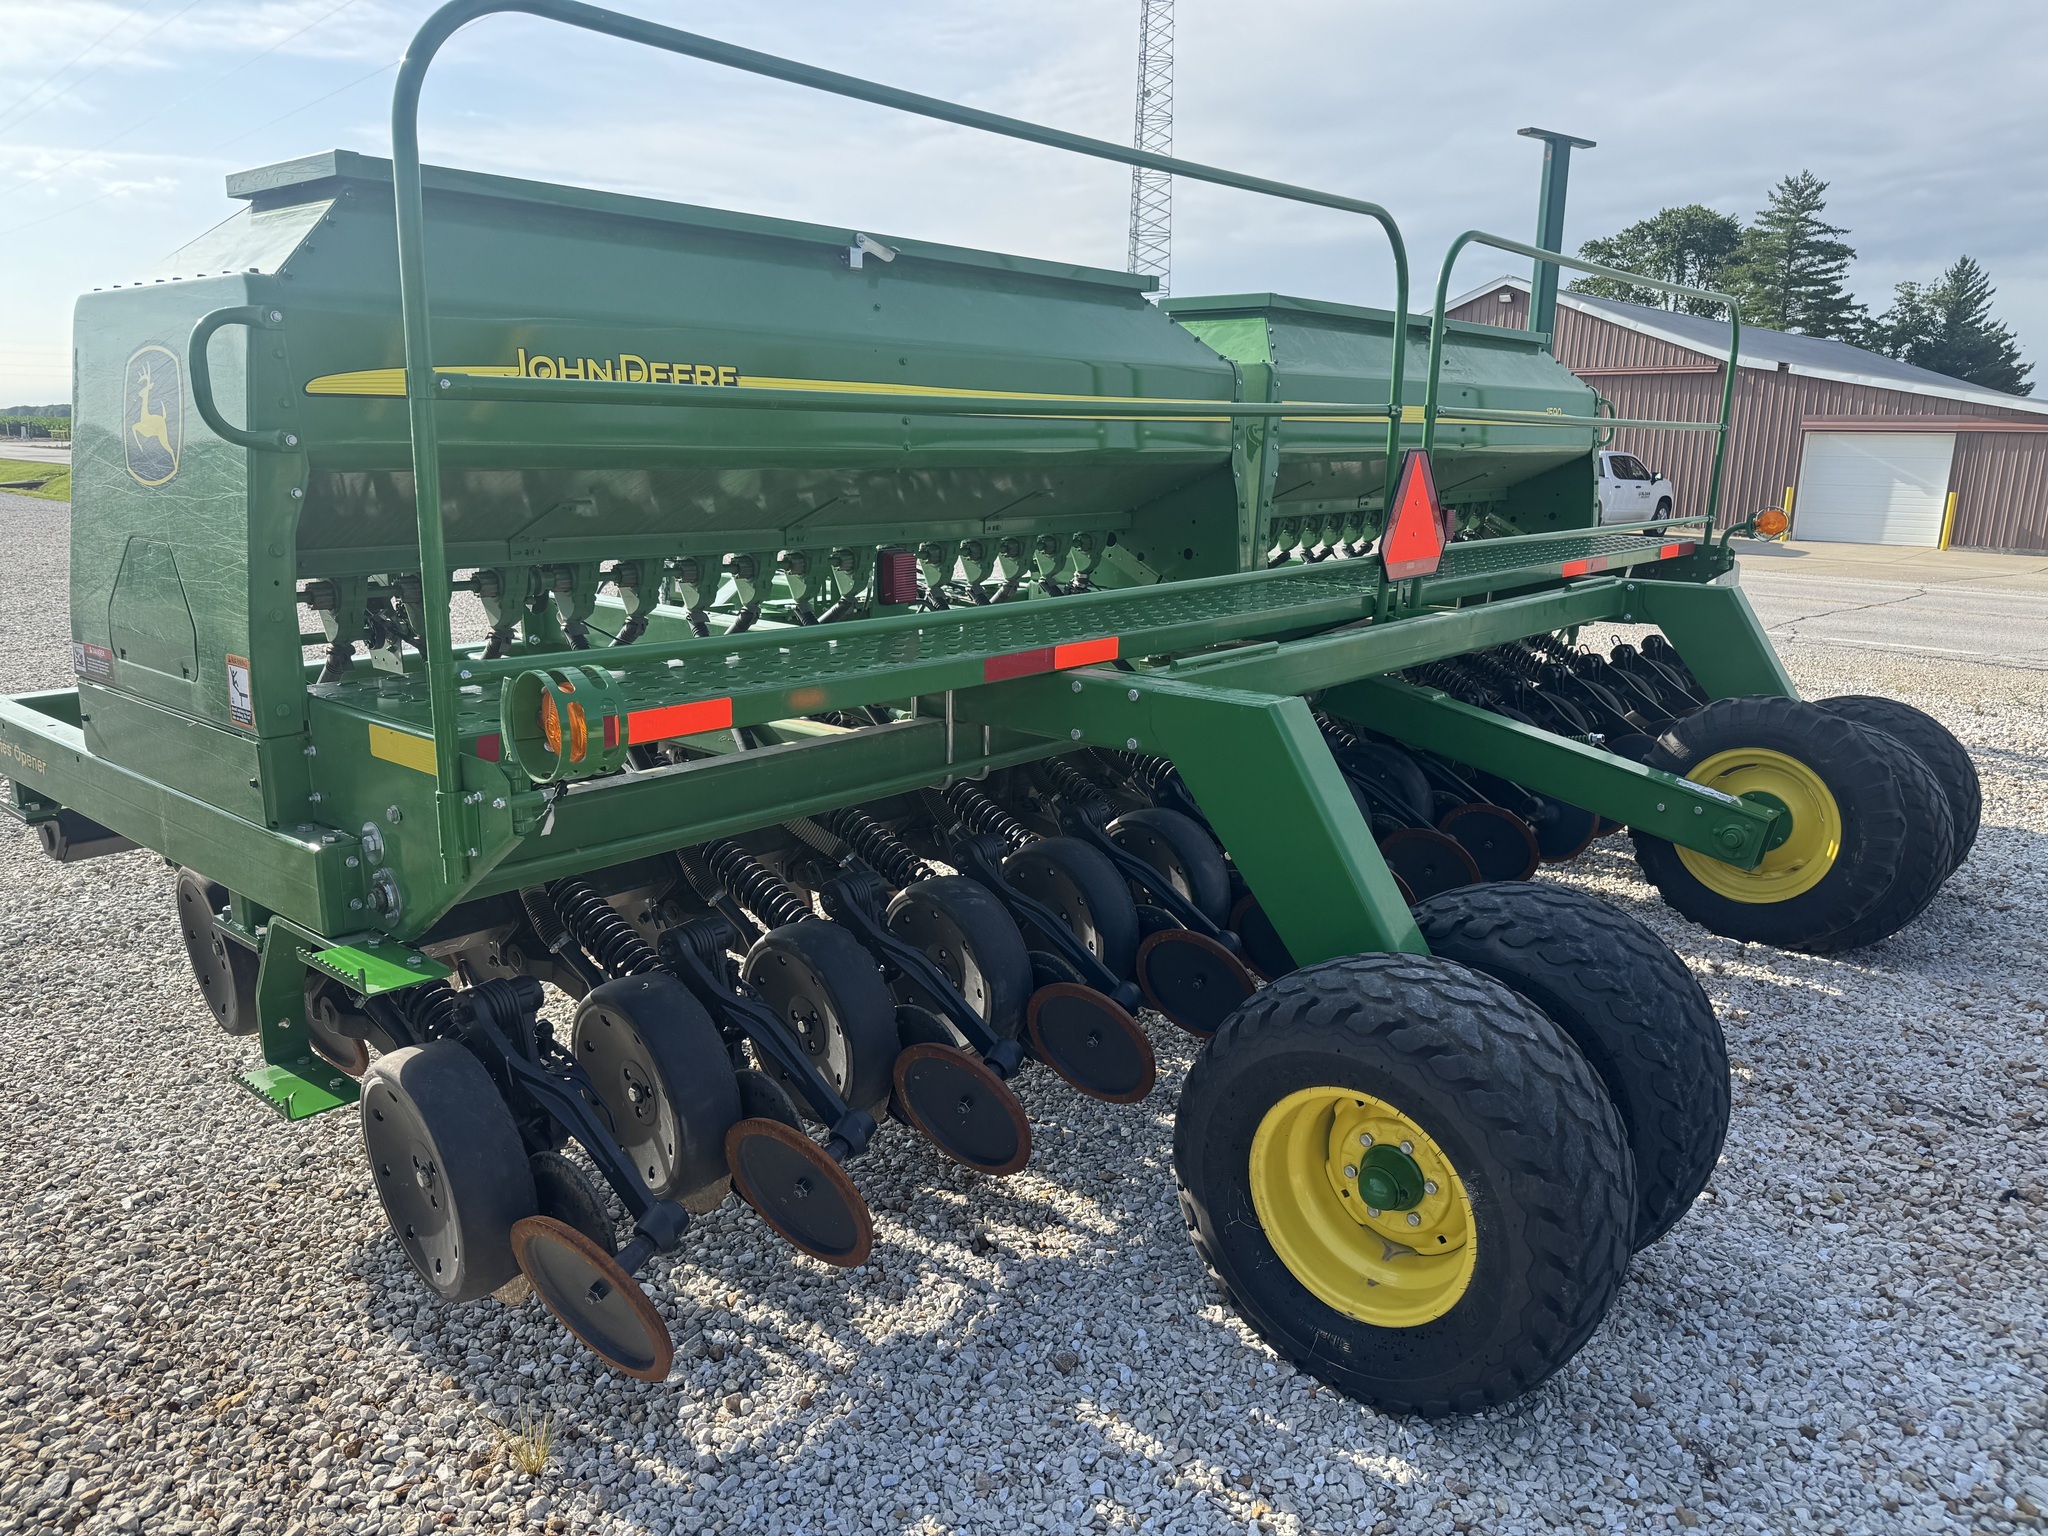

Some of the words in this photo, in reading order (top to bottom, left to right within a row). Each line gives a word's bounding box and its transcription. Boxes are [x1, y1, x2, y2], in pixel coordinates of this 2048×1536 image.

[517, 348, 614, 380] JOHN
[619, 353, 737, 387] DEERE
[13, 744, 47, 775] Opener
